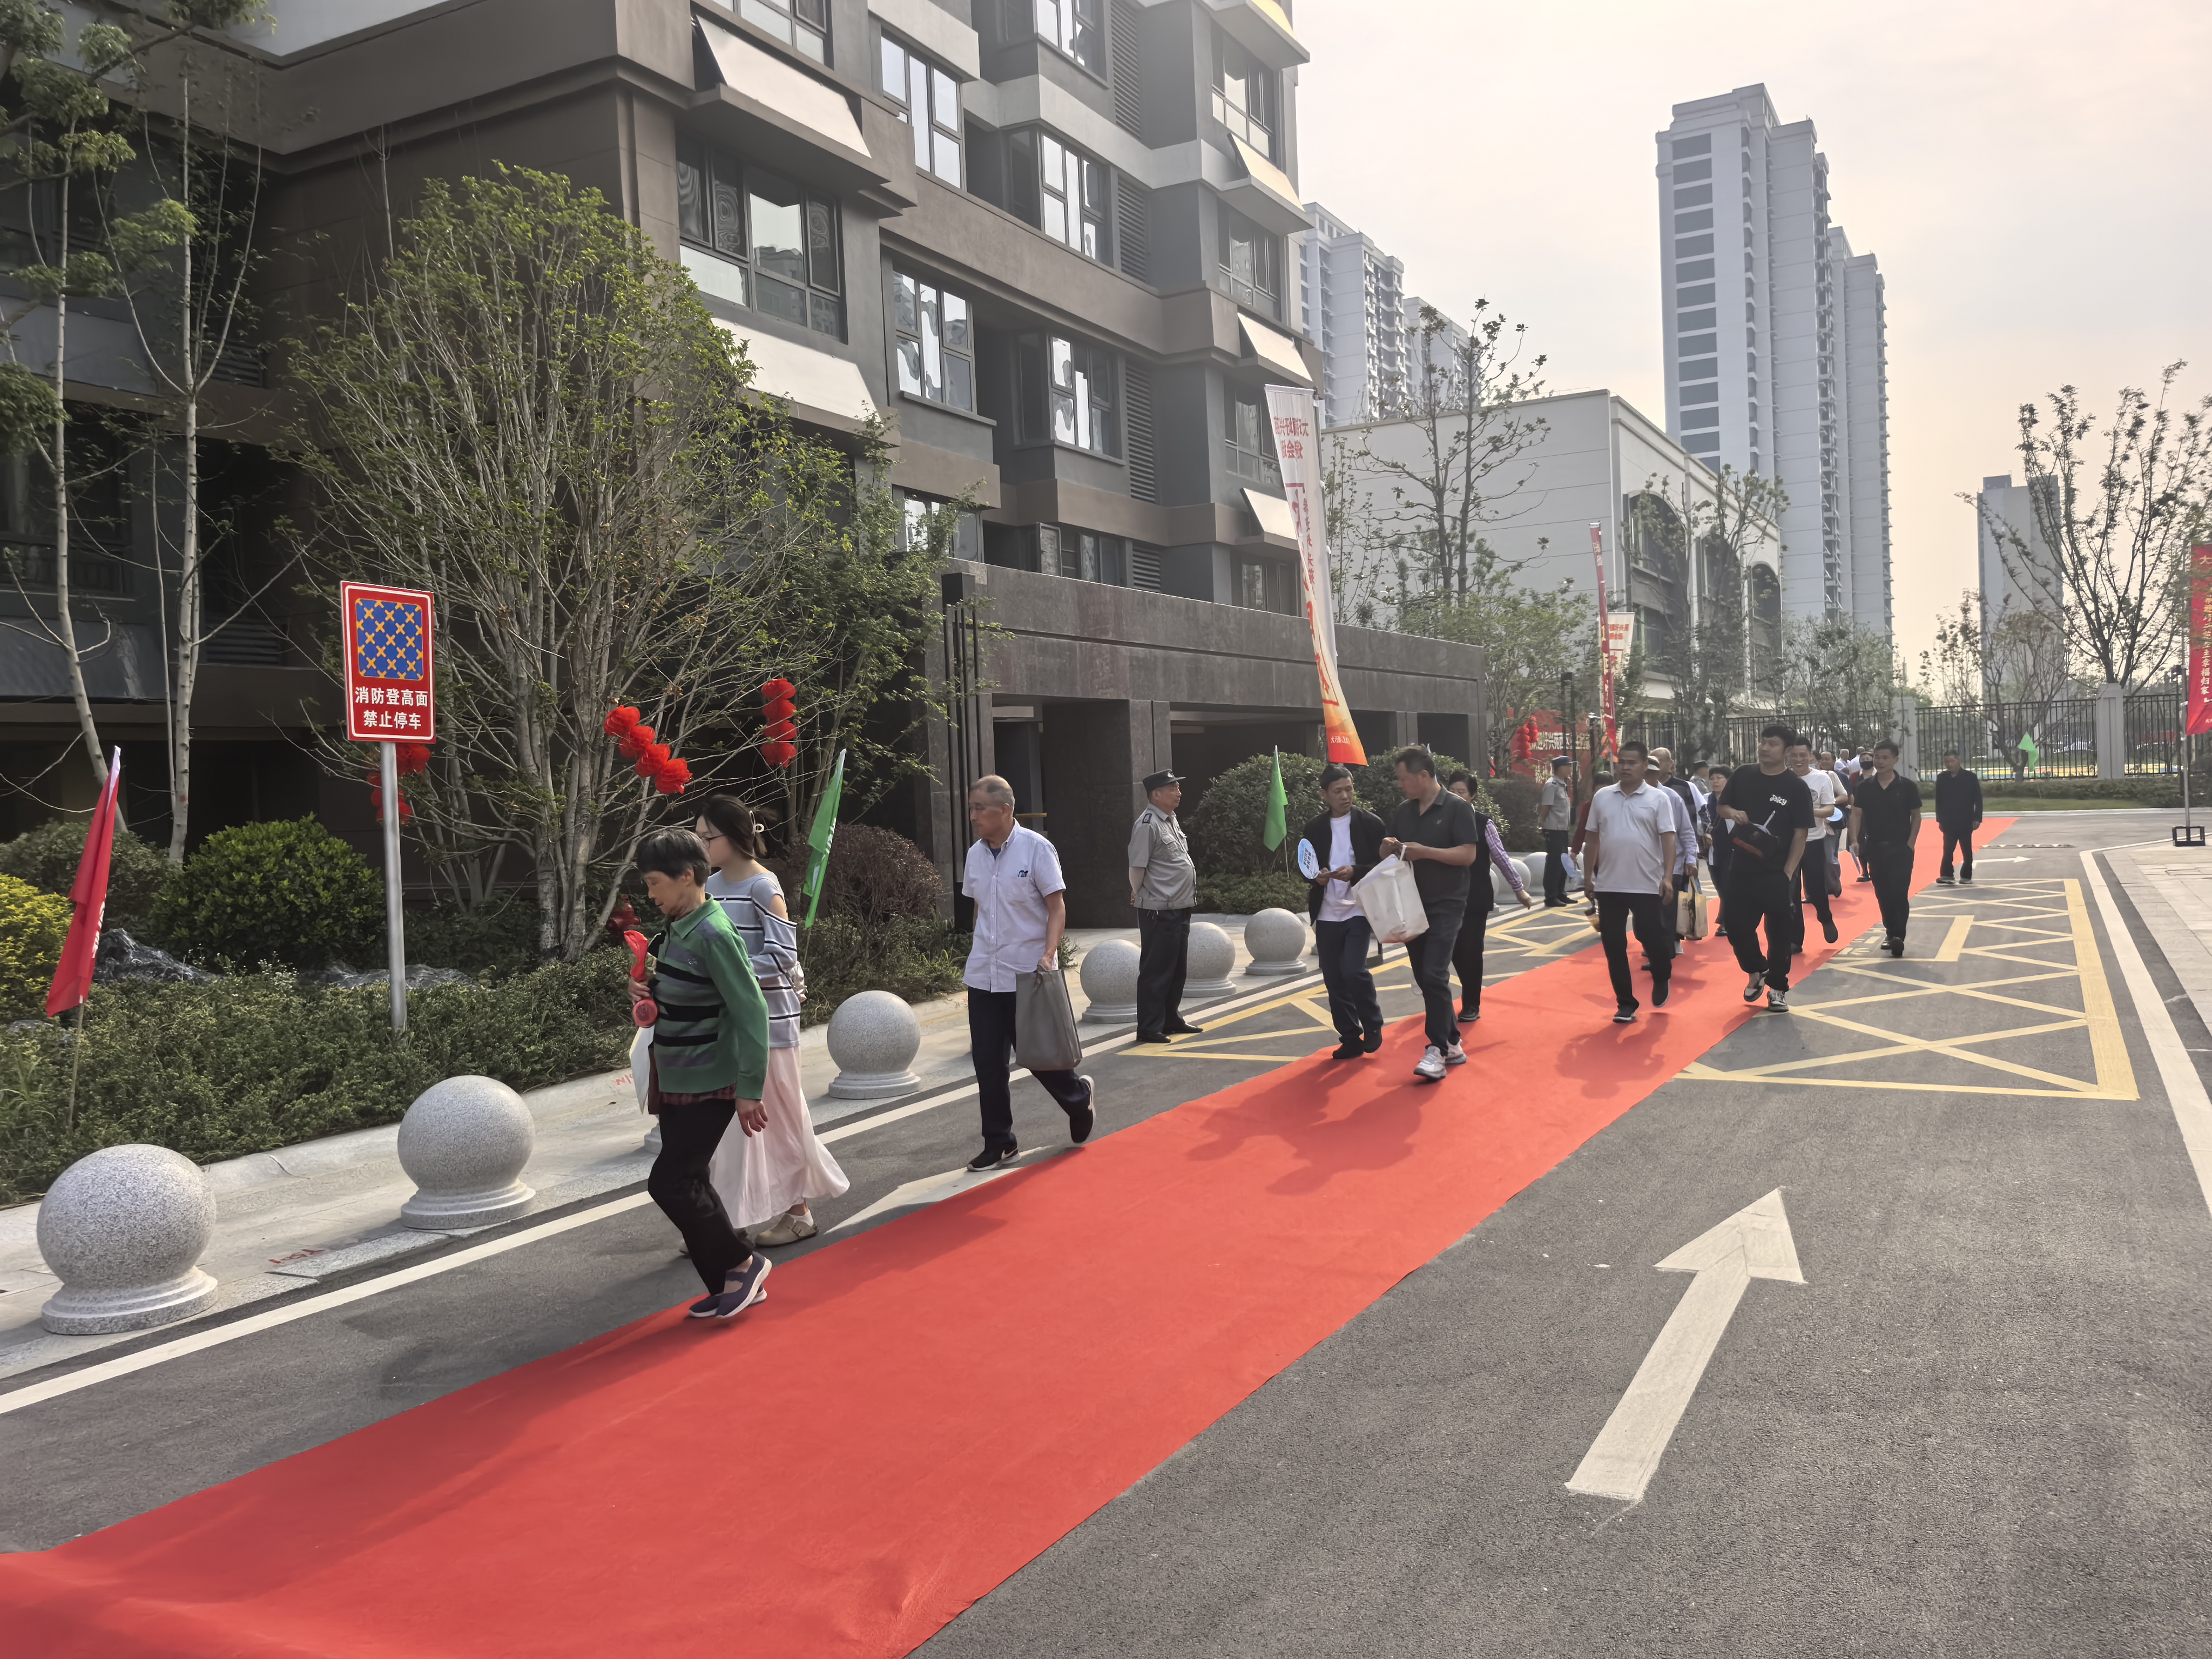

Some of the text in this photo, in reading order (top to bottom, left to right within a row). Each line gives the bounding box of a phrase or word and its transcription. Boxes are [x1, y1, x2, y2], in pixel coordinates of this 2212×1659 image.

[355, 686, 428, 707] 消防登高面
[363, 710, 421, 730] 禁止停车
